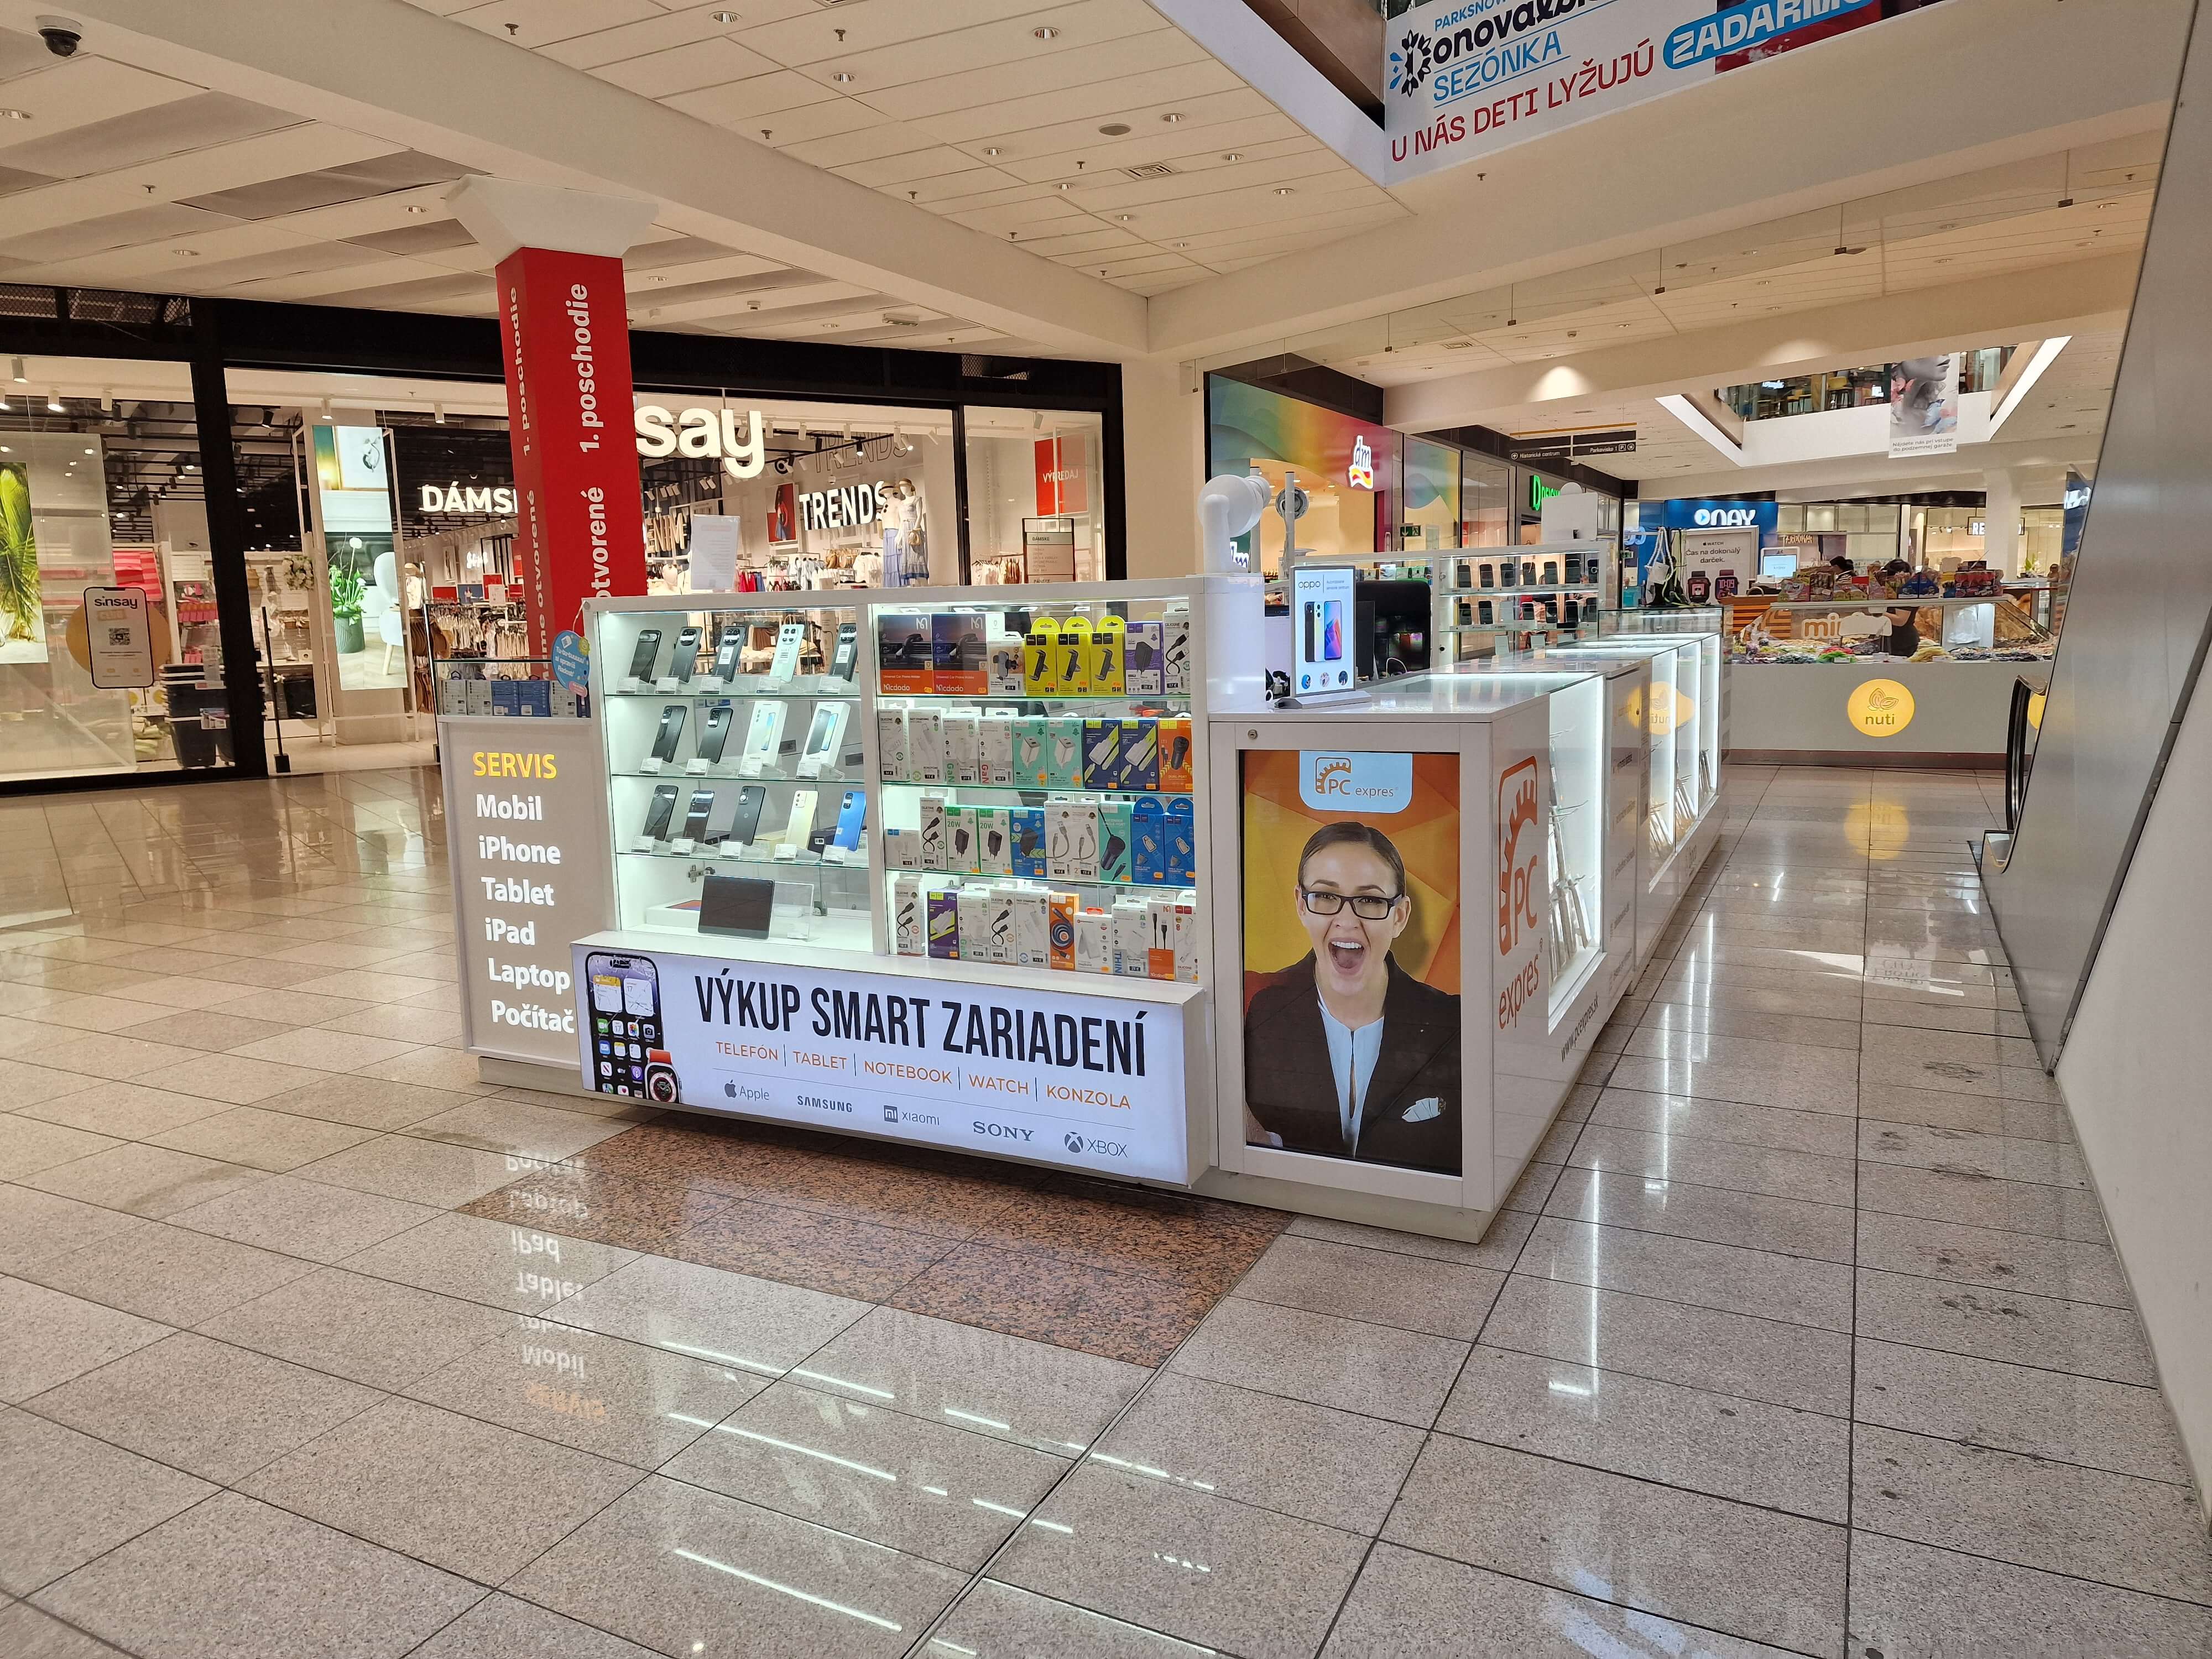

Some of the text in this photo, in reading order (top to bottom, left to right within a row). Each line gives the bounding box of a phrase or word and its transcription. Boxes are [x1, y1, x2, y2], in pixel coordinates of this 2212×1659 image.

[1673, 0, 1863, 64] ZADAR
[1433, 30, 1562, 101] SEZÓNKA
[1392, 38, 1654, 161] U NÁS DETI LYŽUJÚ
[510, 287, 530, 430] poschodie
[566, 284, 604, 453] 1. poschodie
[1042, 469, 1079, 483] VÝPREDAJ
[799, 481, 886, 530] TRENDS
[526, 490, 543, 608] otvorené
[1710, 547, 1741, 555] dokonalý
[1298, 581, 1321, 590] oppo
[94, 596, 138, 609] sinsay
[1804, 614, 1840, 637] mi
[883, 683, 910, 691] Mcdodo
[1865, 713, 1895, 725] nuti
[472, 752, 557, 779] SERVIS
[947, 763, 955, 783] GaN
[1328, 779, 1394, 799] PC expres
[476, 794, 542, 821] Mobil
[479, 835, 561, 865] iPhone
[481, 877, 555, 907] Tablet
[1514, 854, 1538, 946] PC
[484, 917, 535, 946] iPad
[488, 957, 570, 995] Laptop
[1499, 953, 1539, 1030] expres
[491, 999, 575, 1034] Počítač
[695, 968, 1149, 1077] VÝKUP SMART ZARIADENÍ
[716, 1041, 1131, 1109] TELEFÓN TABLET NOTEBOOK WATCH KONZOLA
[739, 1086, 770, 1101] Apple
[797, 1095, 853, 1113] SAMSUNG
[902, 1110, 940, 1126] xiaomi
[973, 1120, 1035, 1142] SONY
[1087, 1138, 1128, 1158] XBOX
